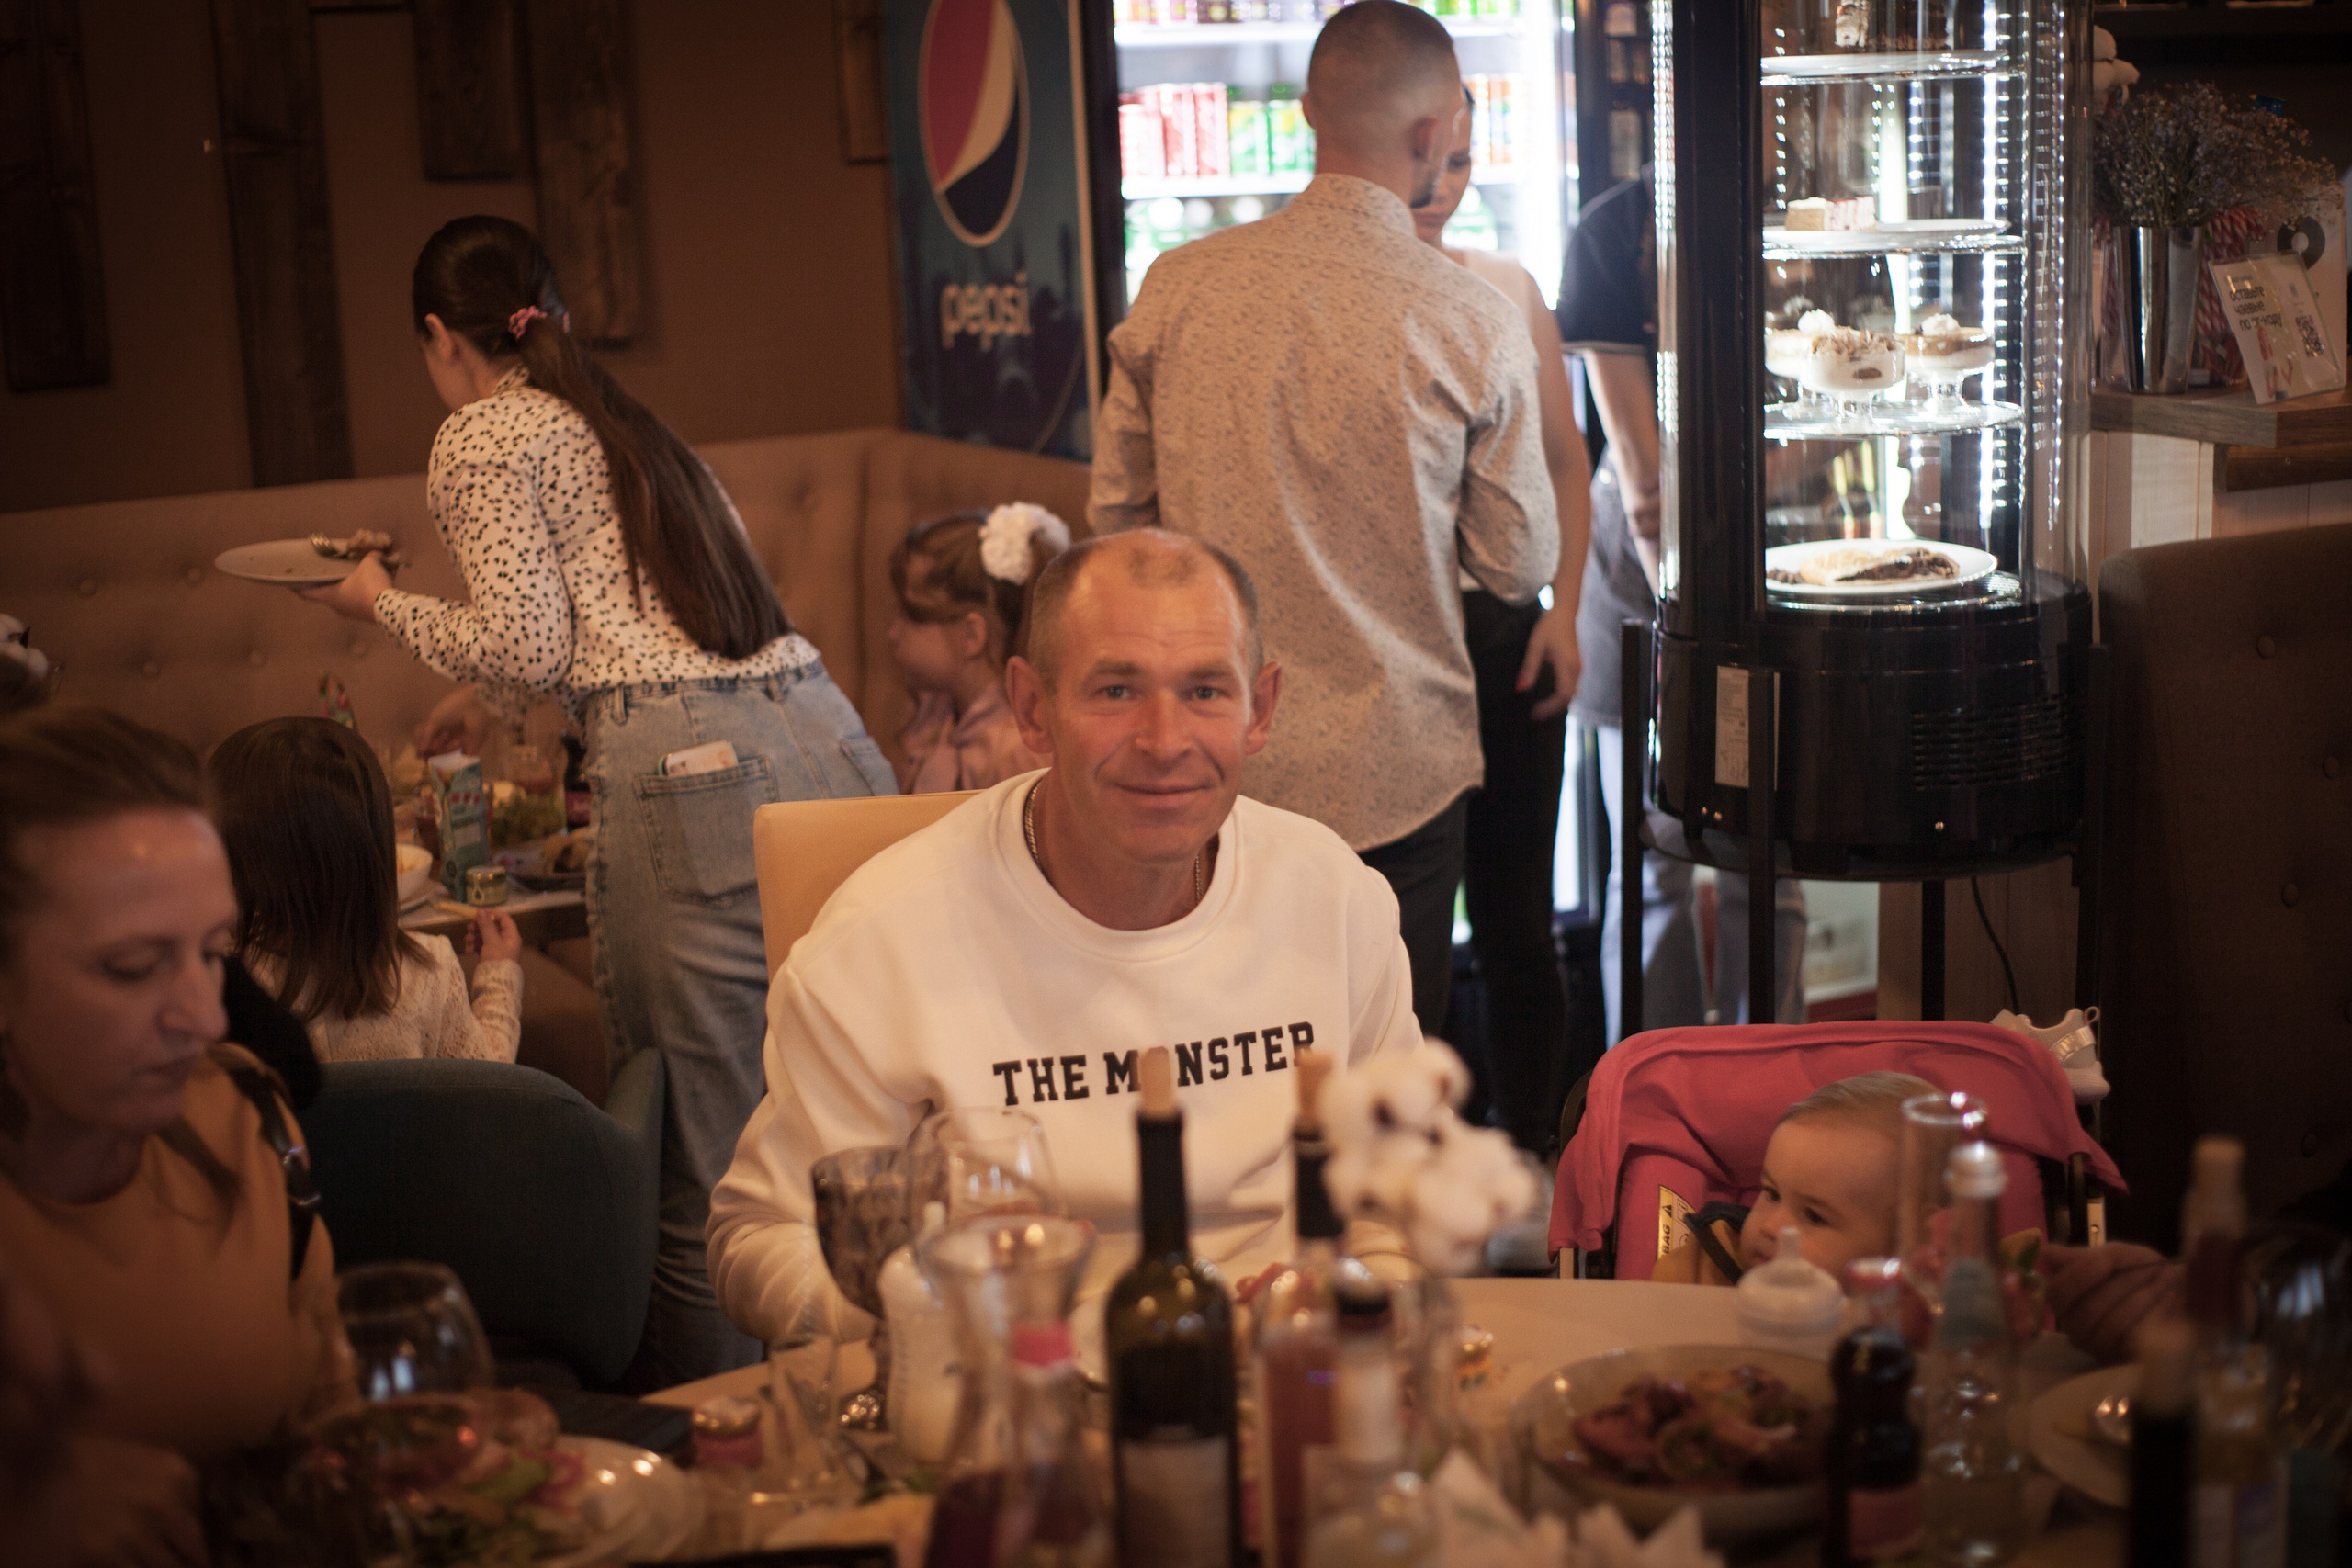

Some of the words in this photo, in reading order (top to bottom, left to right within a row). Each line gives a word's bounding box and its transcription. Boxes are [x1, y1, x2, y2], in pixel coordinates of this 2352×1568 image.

[941, 272, 1033, 352] pepsi
[2233, 301, 2266, 315] чаевые
[2239, 319, 2251, 331] по
[992, 1055, 1090, 1106] THE
[1102, 1021, 1314, 1095] MNSTER
